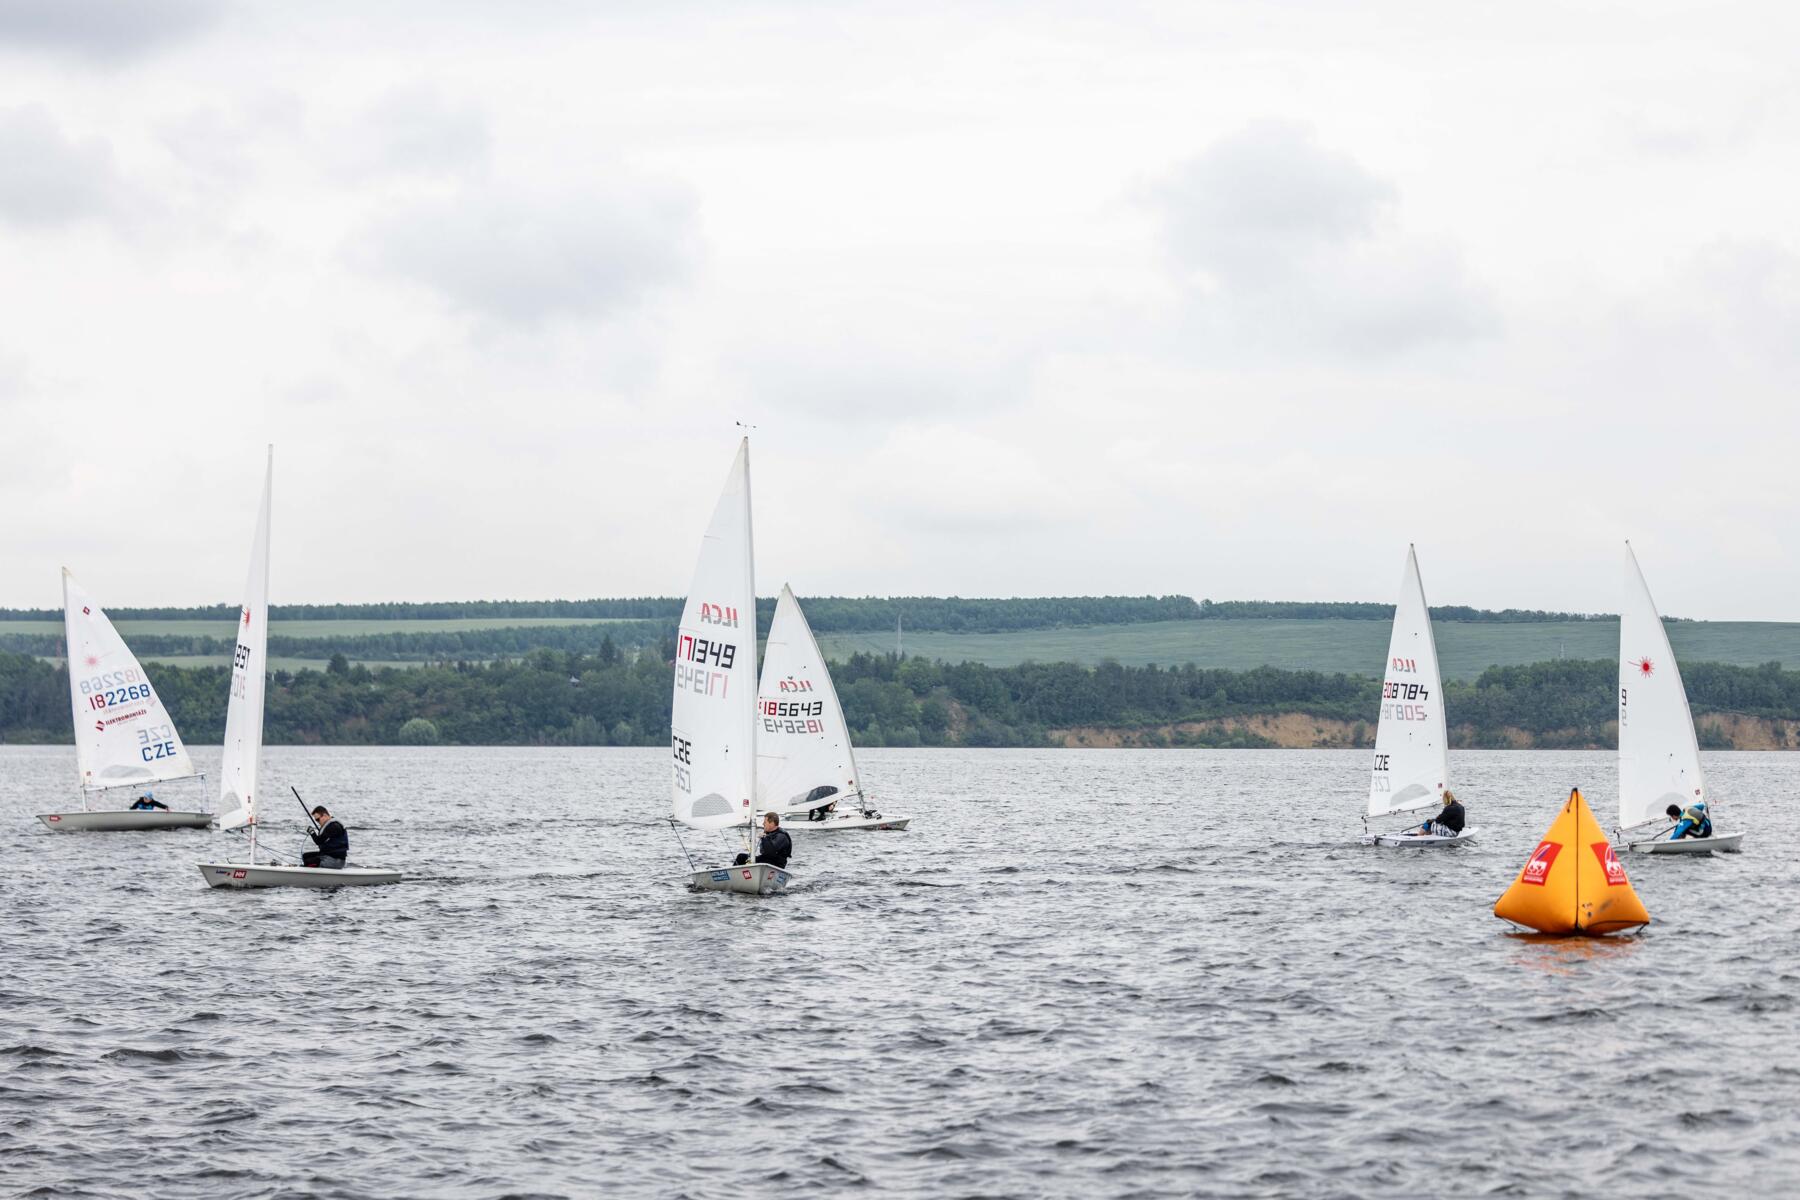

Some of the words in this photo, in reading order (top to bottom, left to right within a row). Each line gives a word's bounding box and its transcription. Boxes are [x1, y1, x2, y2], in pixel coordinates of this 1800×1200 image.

[679, 635, 736, 669] 171349
[89, 684, 150, 710] 182268
[764, 701, 822, 716] 185643
[142, 741, 176, 762] CZE
[673, 736, 691, 765] CZE
[1374, 754, 1389, 771] CZE
